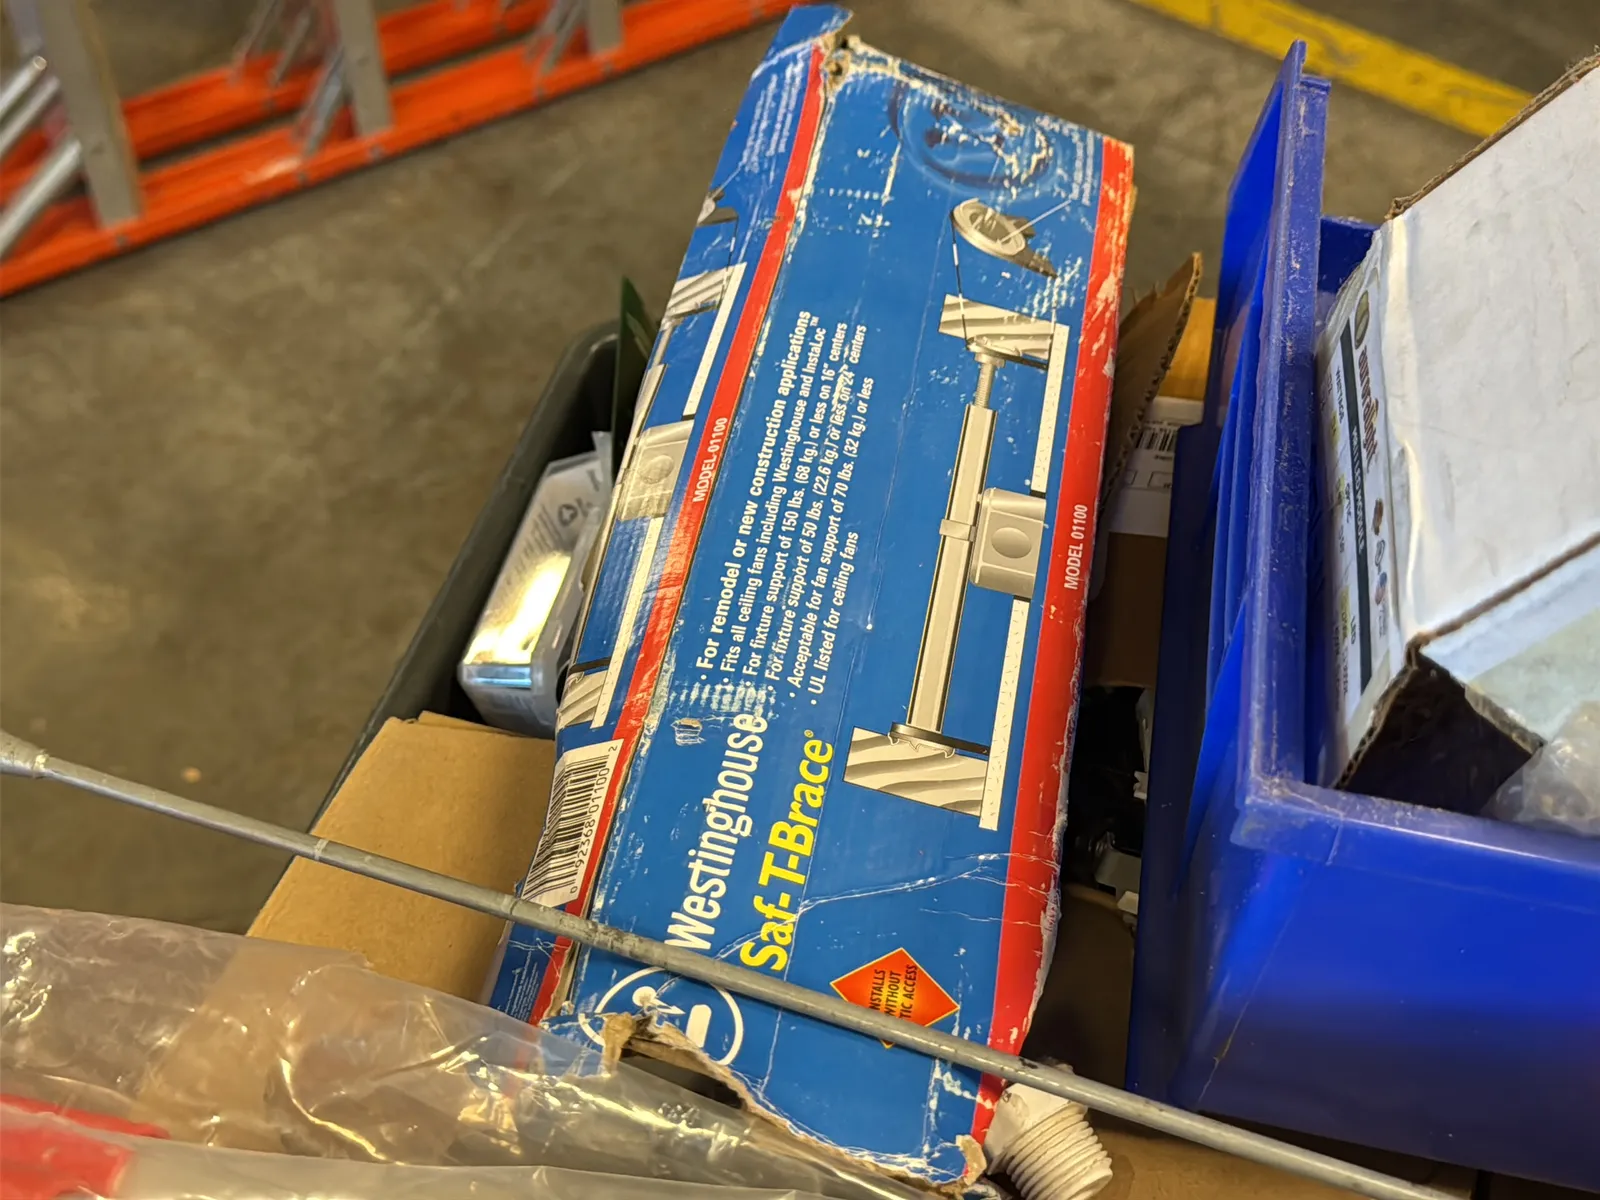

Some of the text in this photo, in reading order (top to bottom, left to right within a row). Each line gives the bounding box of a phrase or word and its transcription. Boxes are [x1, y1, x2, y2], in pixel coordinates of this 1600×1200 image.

[829, 323, 847, 361] centers
[849, 325, 866, 363] centers
[800, 375, 813, 397] and
[819, 385, 831, 399] on
[809, 402, 827, 424] less
[831, 401, 847, 426] less
[772, 400, 807, 482] Westinghouse
[809, 426, 820, 438] or
[829, 426, 841, 440] or
[693, 417, 728, 502] MODEL 01100
[799, 442, 818, 463] kg.)
[794, 466, 810, 483] (68
[812, 466, 831, 496] (22.6
[696, 311, 810, 668] For remodel or new construction applications
[787, 488, 805, 508] lbs.
[756, 486, 787, 544] including
[782, 511, 798, 531] 150
[806, 500, 823, 520] lbs.
[778, 535, 792, 549] of
[787, 378, 874, 688] Acceptable for fan support of 70 lbs. (32 kg.) or less
[802, 522, 817, 538] 50
[799, 538, 813, 554] of
[1064, 504, 1088, 590] MODEL 01100
[747, 547, 768, 574] fans
[766, 552, 788, 602] support
[788, 556, 809, 607] support
[738, 578, 762, 622] ceiling
[808, 532, 858, 694] UL listed for ceiling fans
[731, 625, 746, 642] all
[750, 606, 774, 648] fixture
[773, 607, 796, 654] fixture
[720, 646, 740, 672] Fits
[742, 652, 762, 675] For
[765, 654, 784, 680] For
[570, 886, 578, 894] 0
[574, 818, 596, 868] 92368
[588, 767, 610, 814] 01100
[664, 713, 768, 950] Westinghouse
[869, 969, 886, 1010] NSTALLS
[899, 964, 918, 1019] TIC ACCESS
